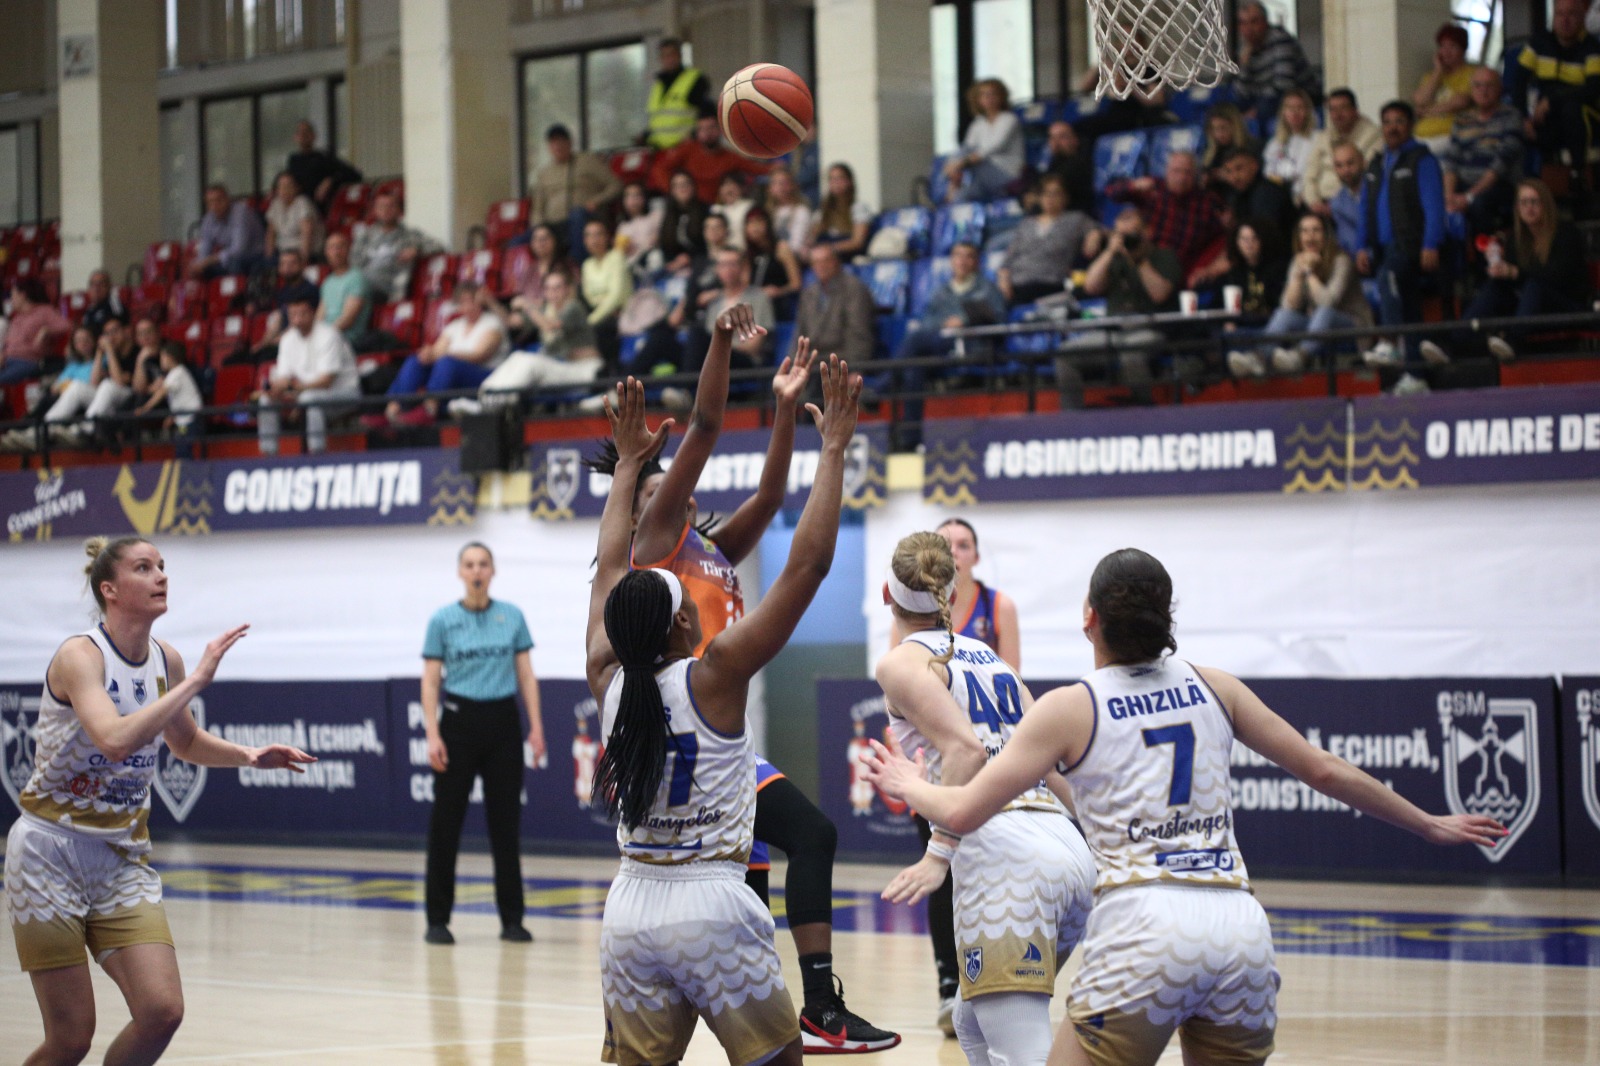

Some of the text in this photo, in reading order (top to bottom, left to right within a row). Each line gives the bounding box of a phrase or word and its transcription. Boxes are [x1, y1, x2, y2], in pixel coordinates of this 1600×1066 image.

[984, 429, 1277, 478] #OSINGURAECHIPA
[1426, 421, 1450, 459] O
[1455, 416, 1553, 457] MARE
[962, 670, 1023, 734] 40
[1437, 691, 1486, 717] CSM
[1141, 721, 1196, 807] 7
